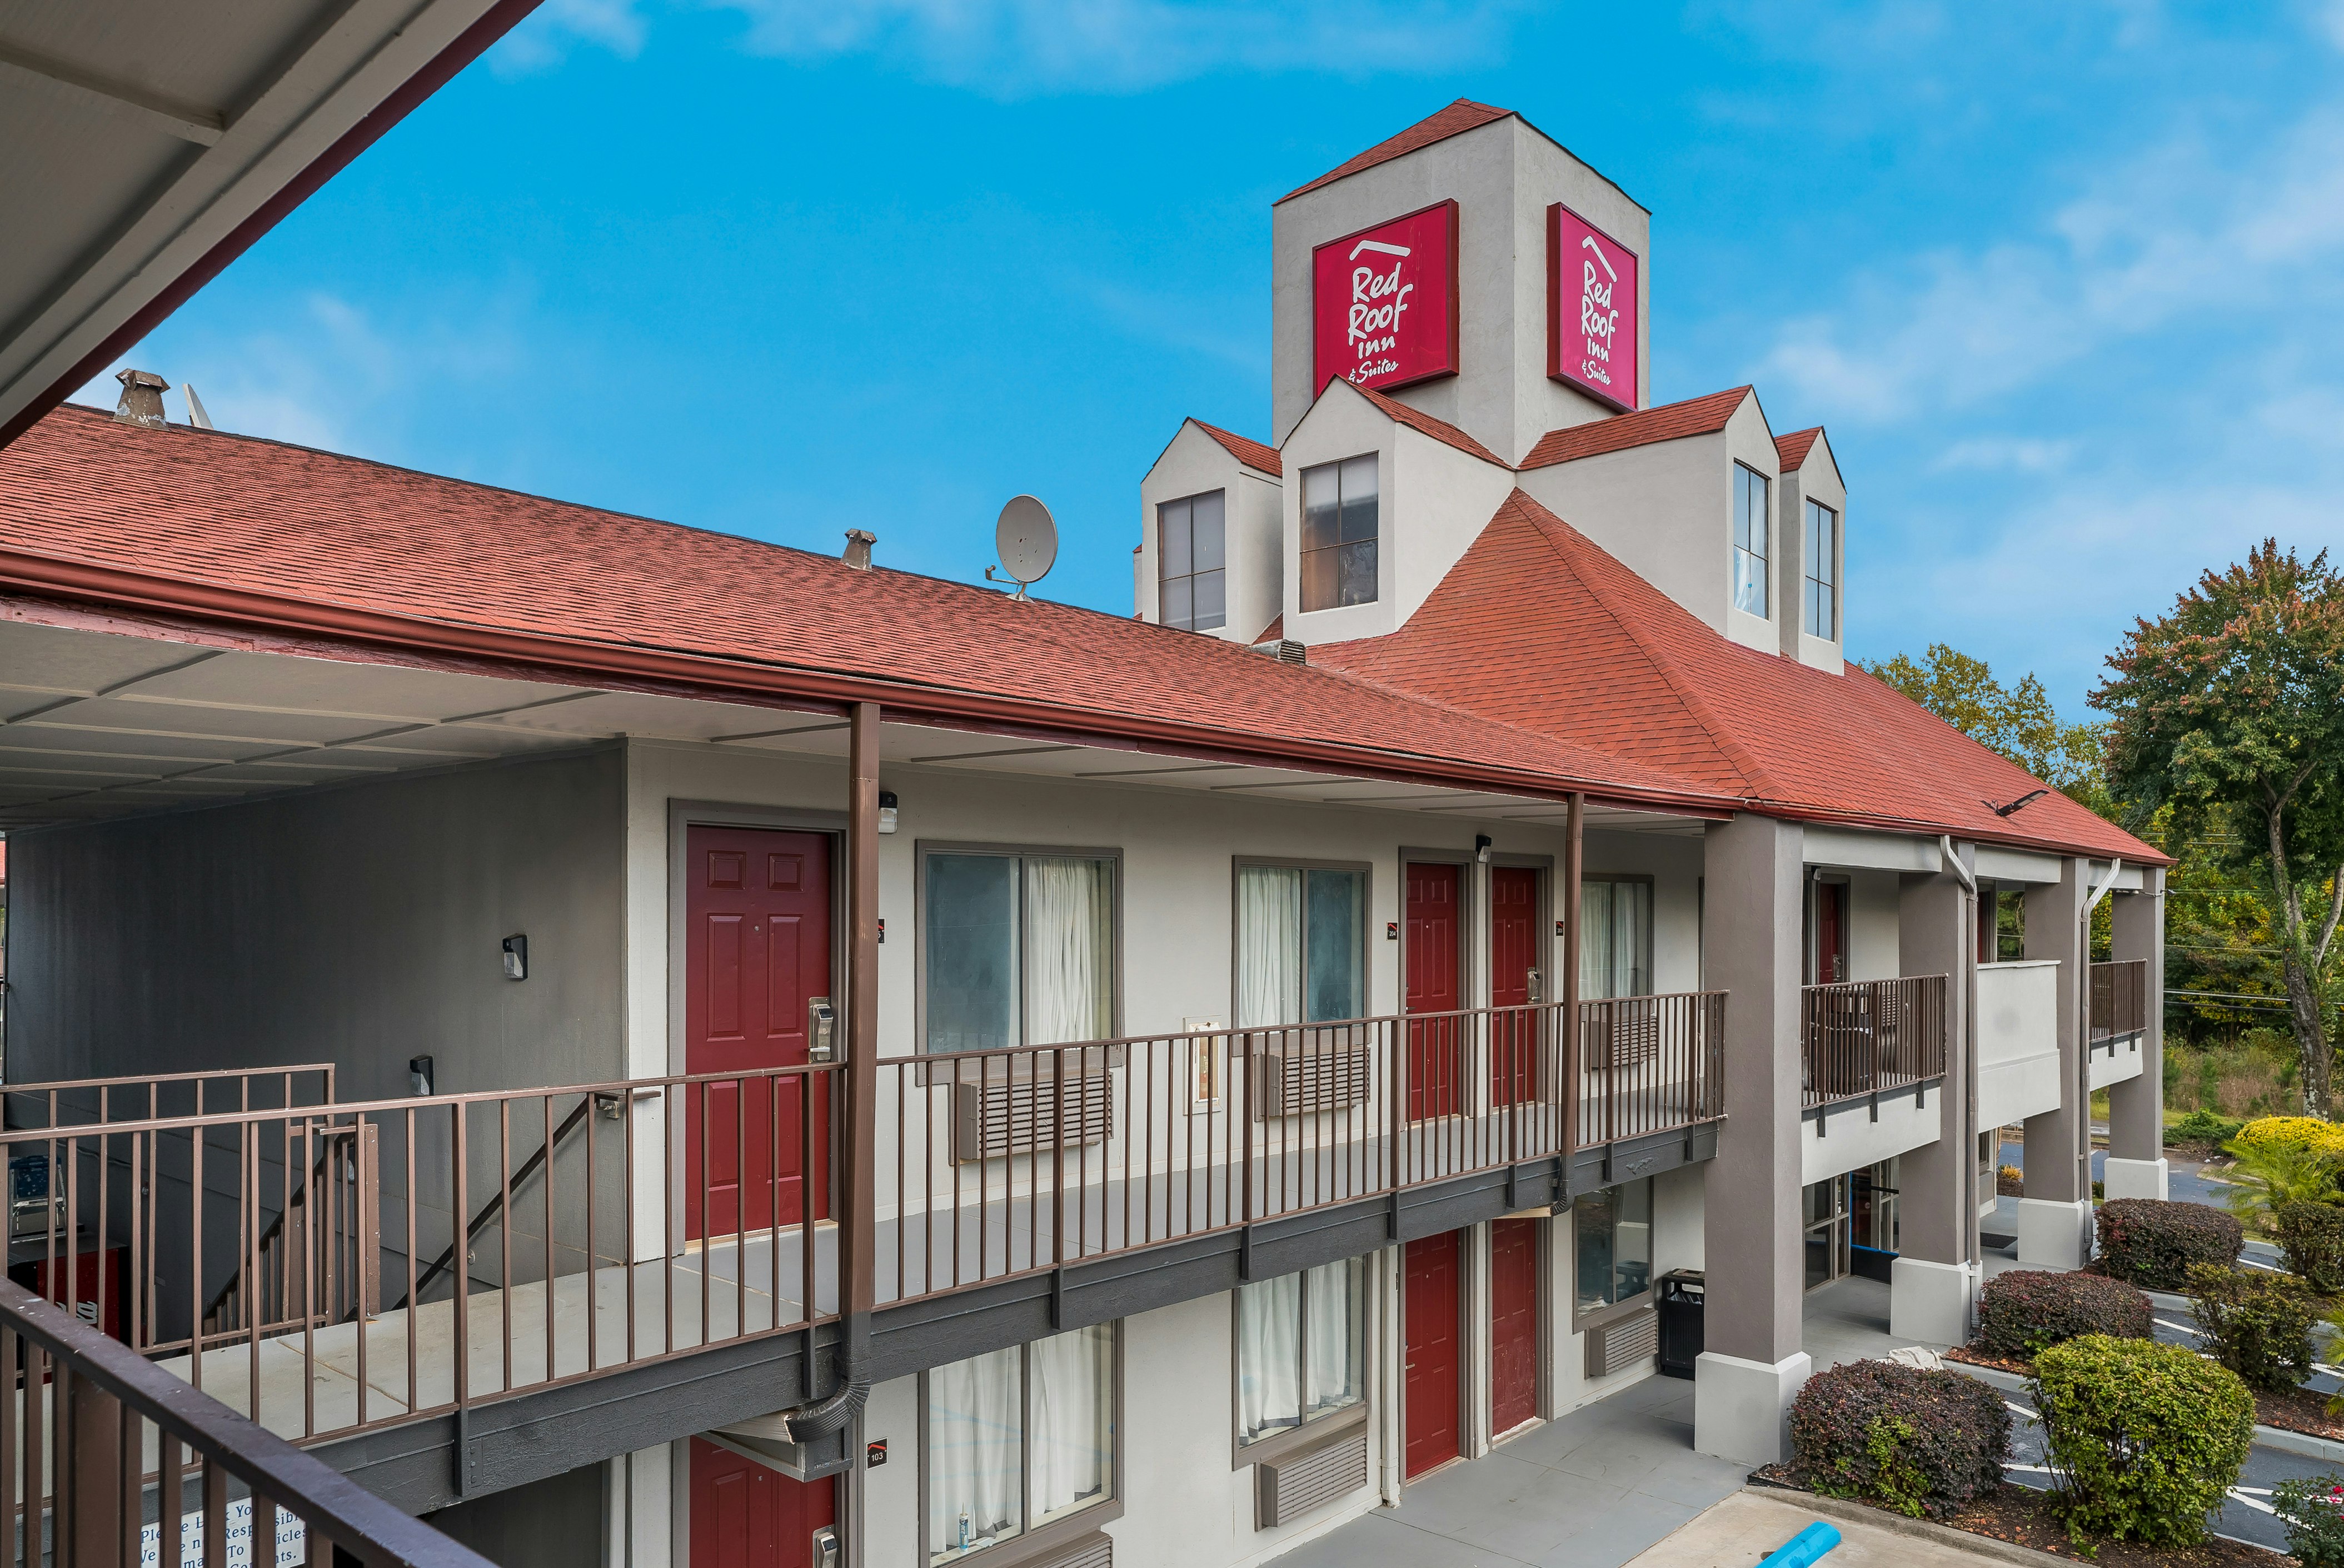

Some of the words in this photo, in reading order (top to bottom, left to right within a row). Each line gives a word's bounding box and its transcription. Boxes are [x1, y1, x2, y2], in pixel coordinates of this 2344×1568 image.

[1352, 261, 1402, 303] Red
[1584, 259, 1612, 310] Red
[1348, 283, 1413, 346] Roof
[1581, 294, 1618, 349] Roof
[1348, 368, 1356, 382] &
[1356, 358, 1399, 384] Suites
[1582, 359, 1587, 374] &
[1587, 360, 1611, 386] Suites
[871, 1452, 884, 1462] 103
[227, 1545, 245, 1558] To
